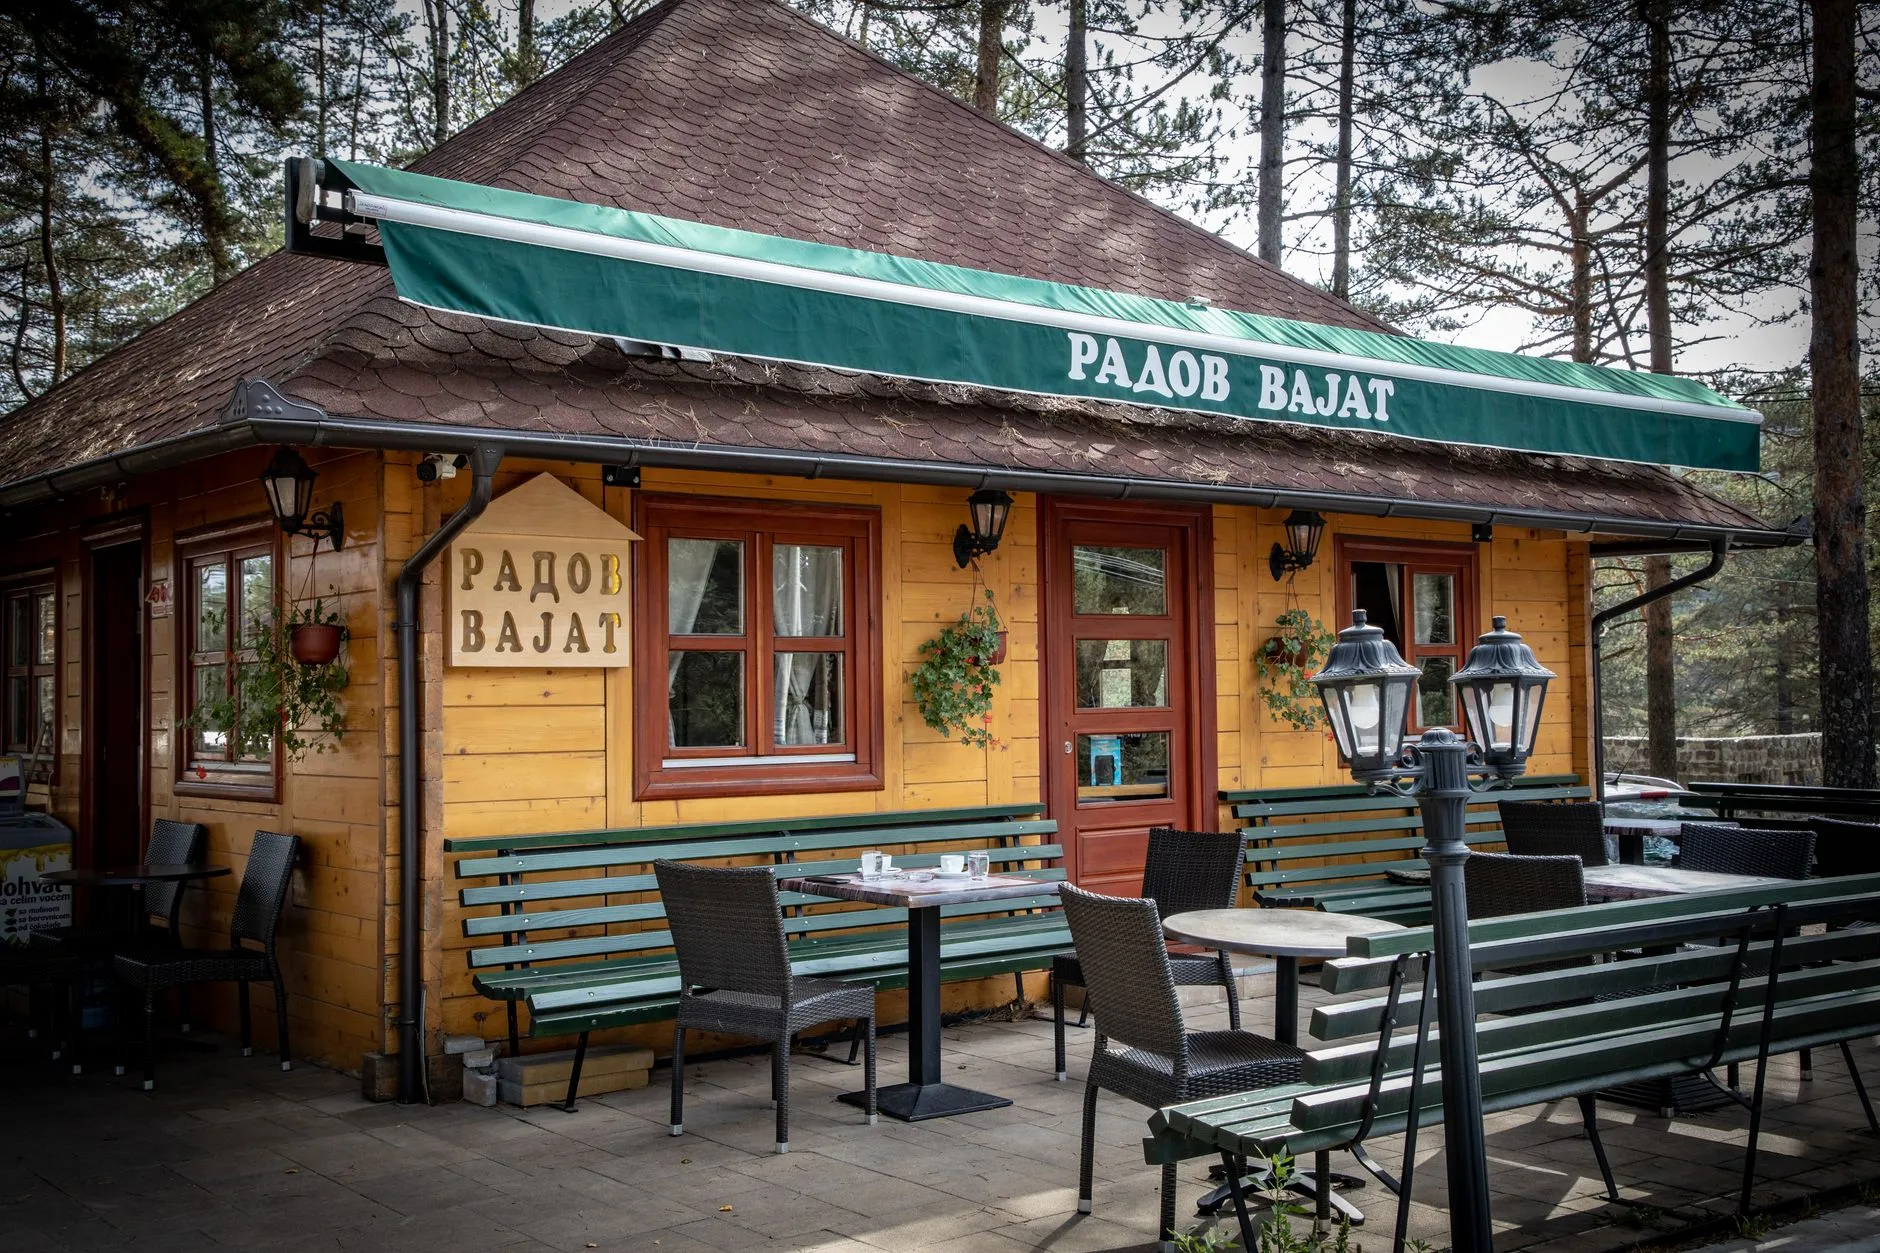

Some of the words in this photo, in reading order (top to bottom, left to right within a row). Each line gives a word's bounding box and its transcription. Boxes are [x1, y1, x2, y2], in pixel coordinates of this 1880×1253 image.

[1067, 332, 1231, 402] РАДОВ
[1257, 364, 1395, 422] ВАЈАТ
[459, 548, 623, 604] РАДОВ
[460, 609, 622, 654] ВАЈАТ
[10, 895, 37, 905] celim
